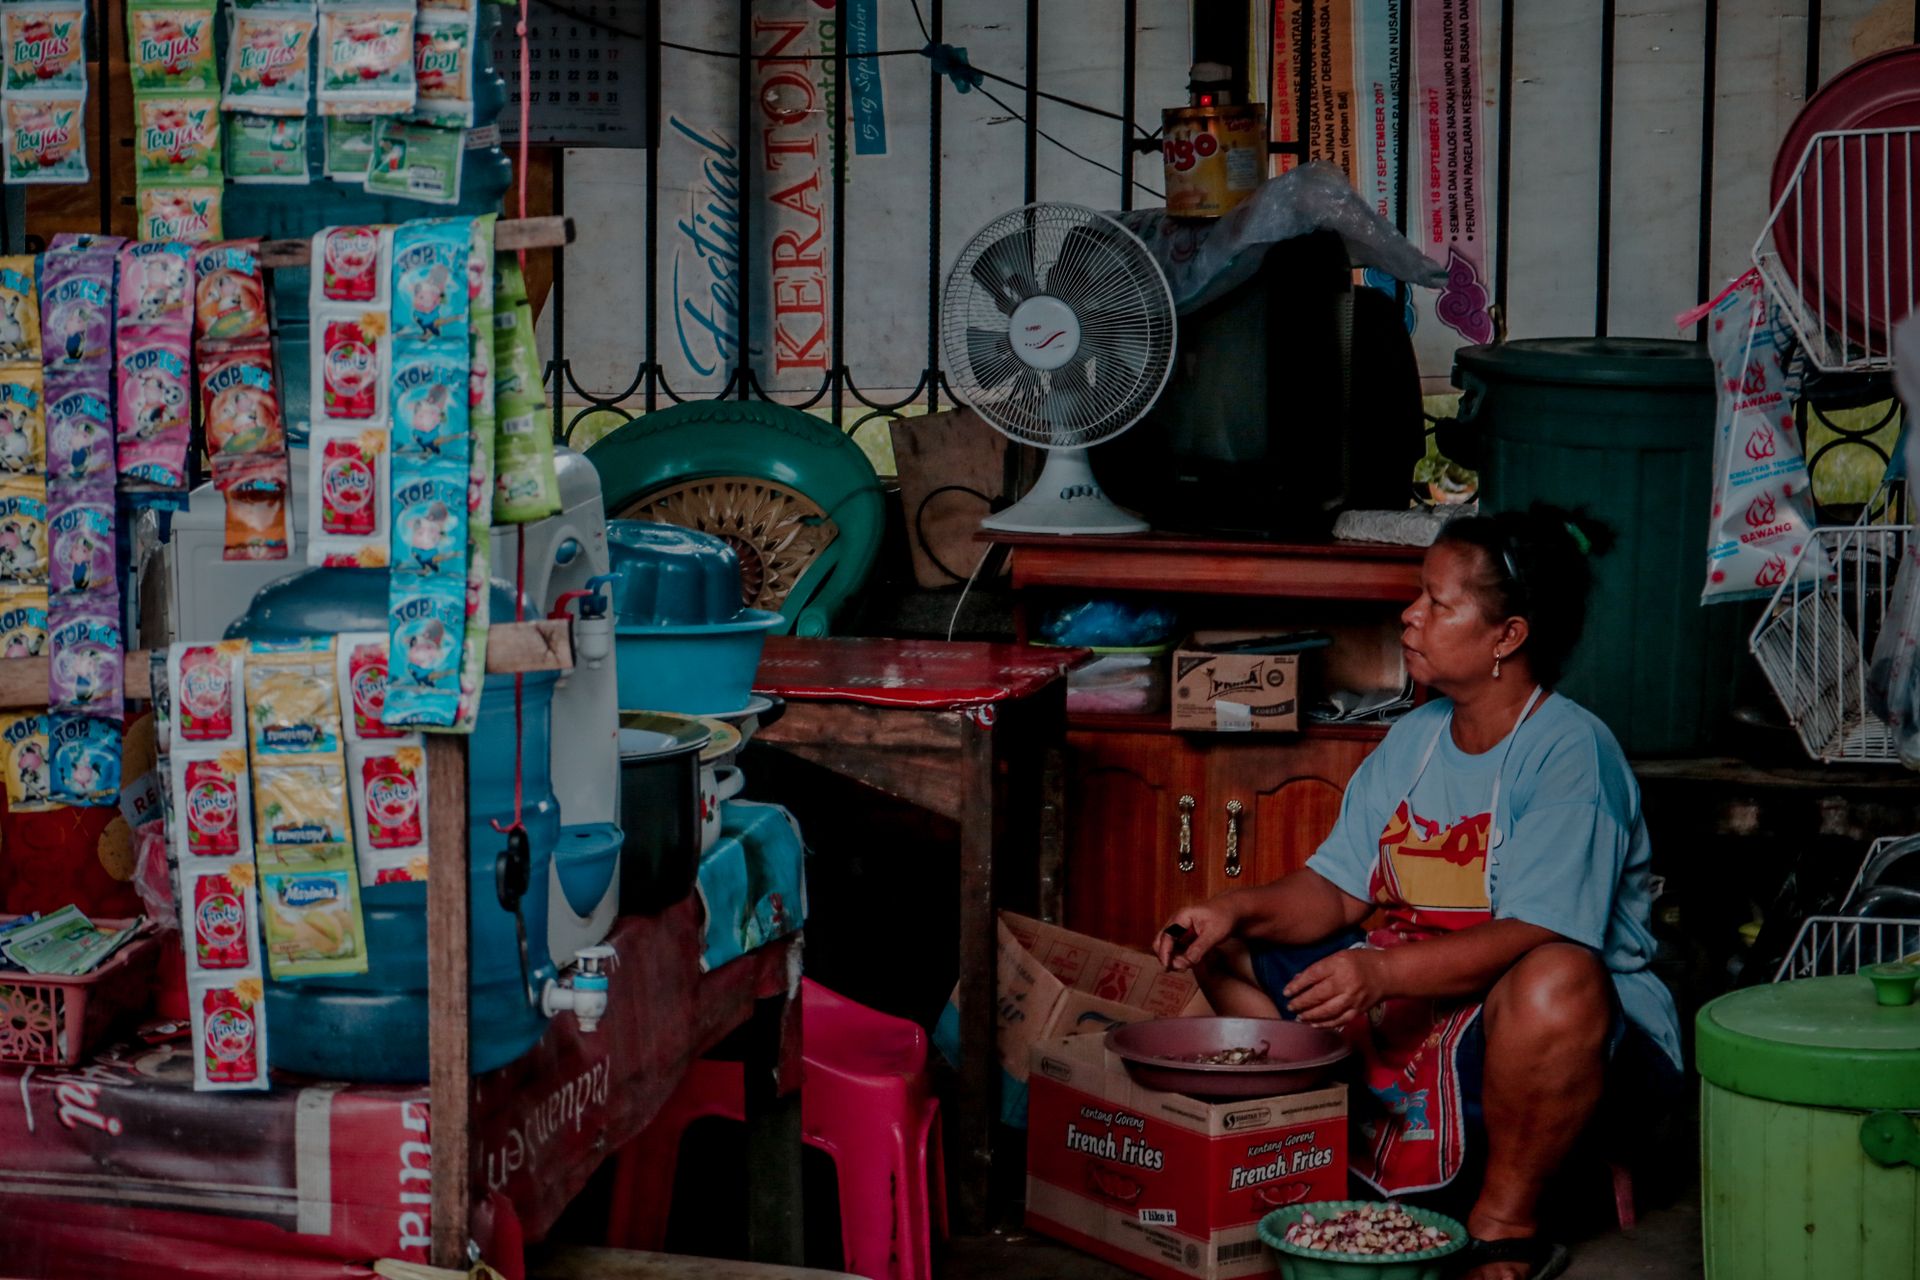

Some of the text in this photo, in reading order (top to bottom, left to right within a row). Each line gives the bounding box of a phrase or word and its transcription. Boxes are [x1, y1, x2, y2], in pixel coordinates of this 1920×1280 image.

[550, 49, 560, 59] 14
[569, 49, 580, 59] 15
[588, 49, 599, 59] 16
[1320, 5, 1331, 82] DEKRANASDA
[1443, 12, 1454, 59] KERATON
[1459, 22, 1470, 63] BUSANA
[549, 70, 560, 80] 21
[568, 70, 580, 80] 22
[587, 70, 599, 80] 23
[607, 70, 619, 80] 24
[1445, 61, 1455, 86] KUNO
[549, 91, 560, 101] 28
[568, 91, 580, 101] 29
[587, 91, 599, 101] 30
[607, 91, 618, 101] 31
[1322, 85, 1333, 121] RAKYAT
[1374, 82, 1384, 105] 2017
[1445, 88, 1456, 129] NASKAH
[1375, 107, 1387, 177] SEPTEMBER
[1446, 132, 1457, 166] DIALOG
[1462, 116, 1474, 175] PAGELARAN
[1428, 89, 1443, 243] SENIN, 18 SEPTEMBER 2017
[1447, 170, 1457, 191] DAN
[754, 17, 831, 375] KERATON
[1448, 193, 1459, 233] SEMINAR
[1464, 178, 1475, 233] PENUTUPAN
[1740, 522, 1792, 544] BAWANG
[1081, 1106, 1112, 1127] Kentang
[1115, 1112, 1144, 1133] Goreng
[1066, 1123, 1163, 1169] French Fries
[1248, 1131, 1316, 1157] Kentang Goreng
[1231, 1147, 1332, 1190] French Fries
[1148, 1210, 1165, 1222] like
[1166, 1211, 1175, 1222] it
